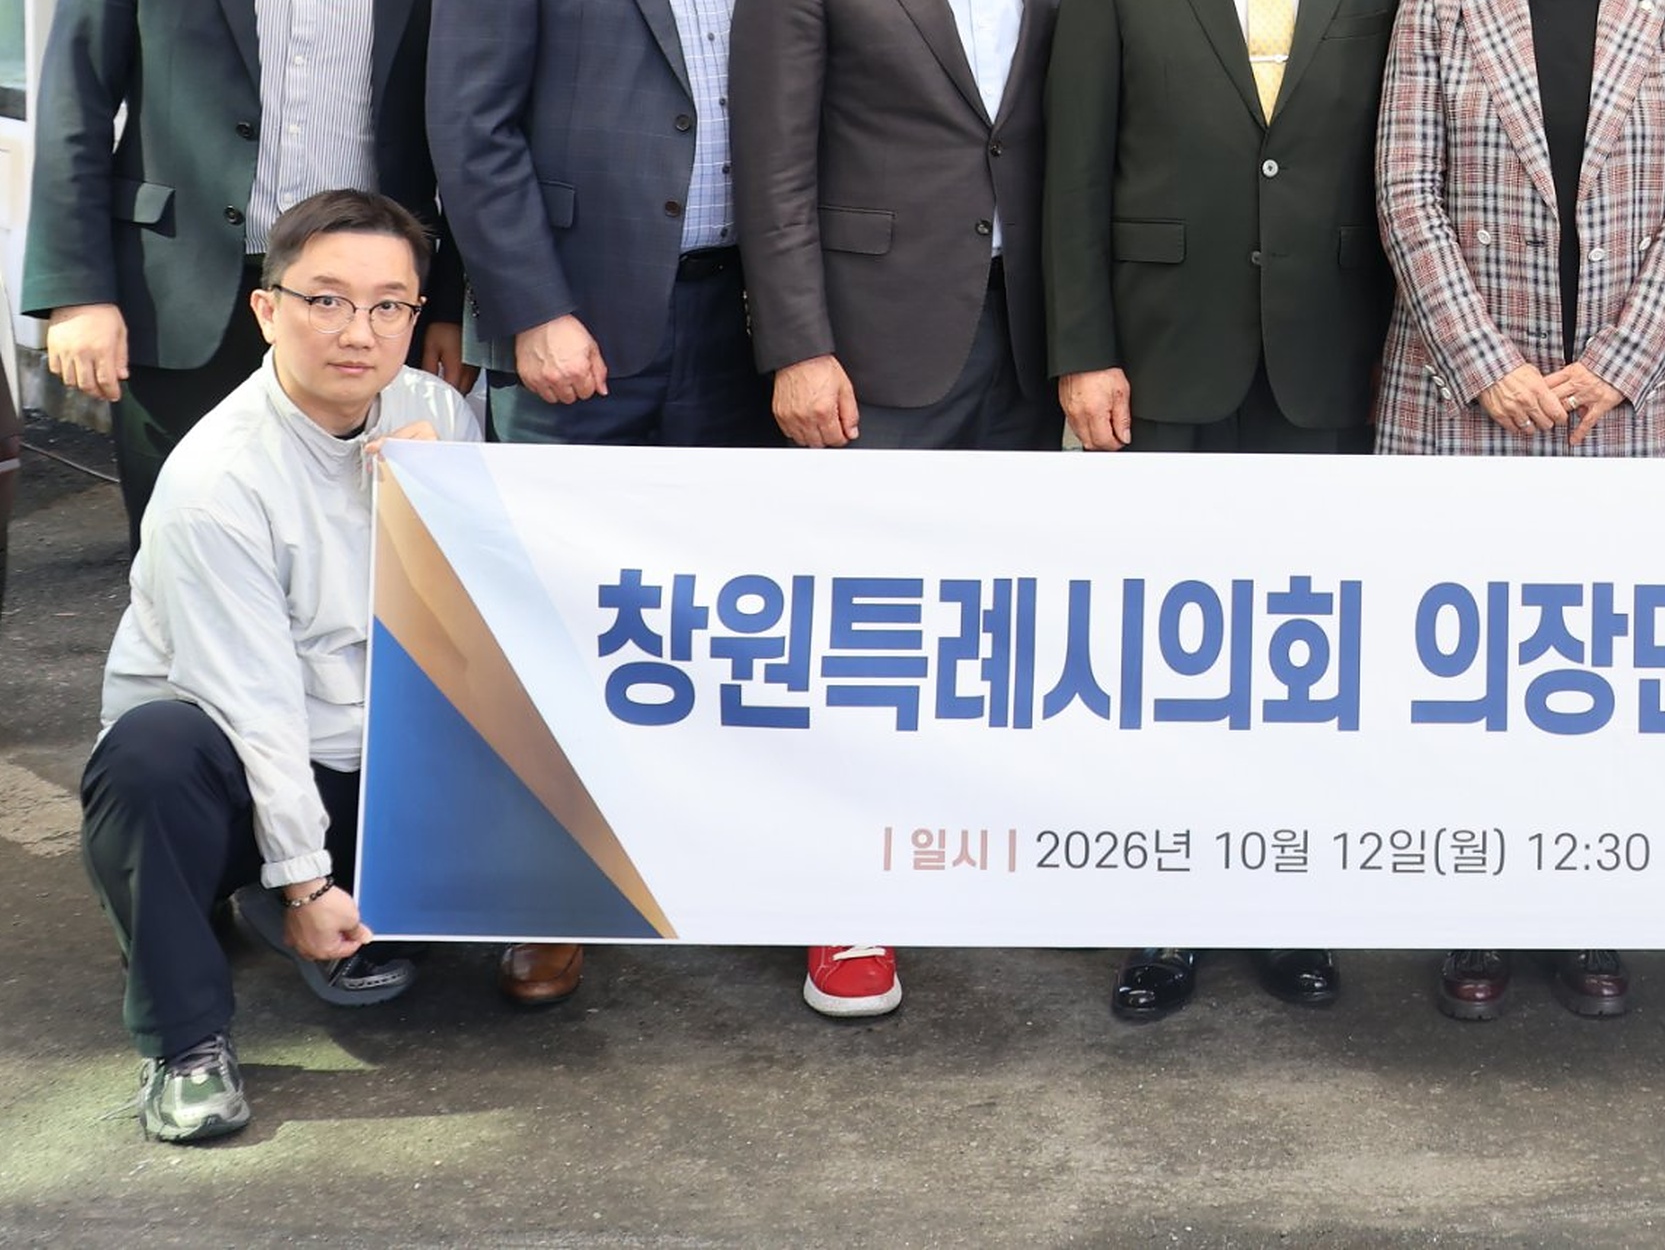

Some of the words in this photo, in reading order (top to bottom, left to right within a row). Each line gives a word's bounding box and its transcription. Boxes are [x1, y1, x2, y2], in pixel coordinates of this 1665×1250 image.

[598, 569, 1360, 731] 창원특례시의회
[911, 827, 989, 871] 일시
[1036, 829, 1191, 872] 2026년
[1215, 829, 1309, 873] 10월
[1333, 827, 1505, 876] 12일(월)
[1528, 832, 1650, 872] 12:30
